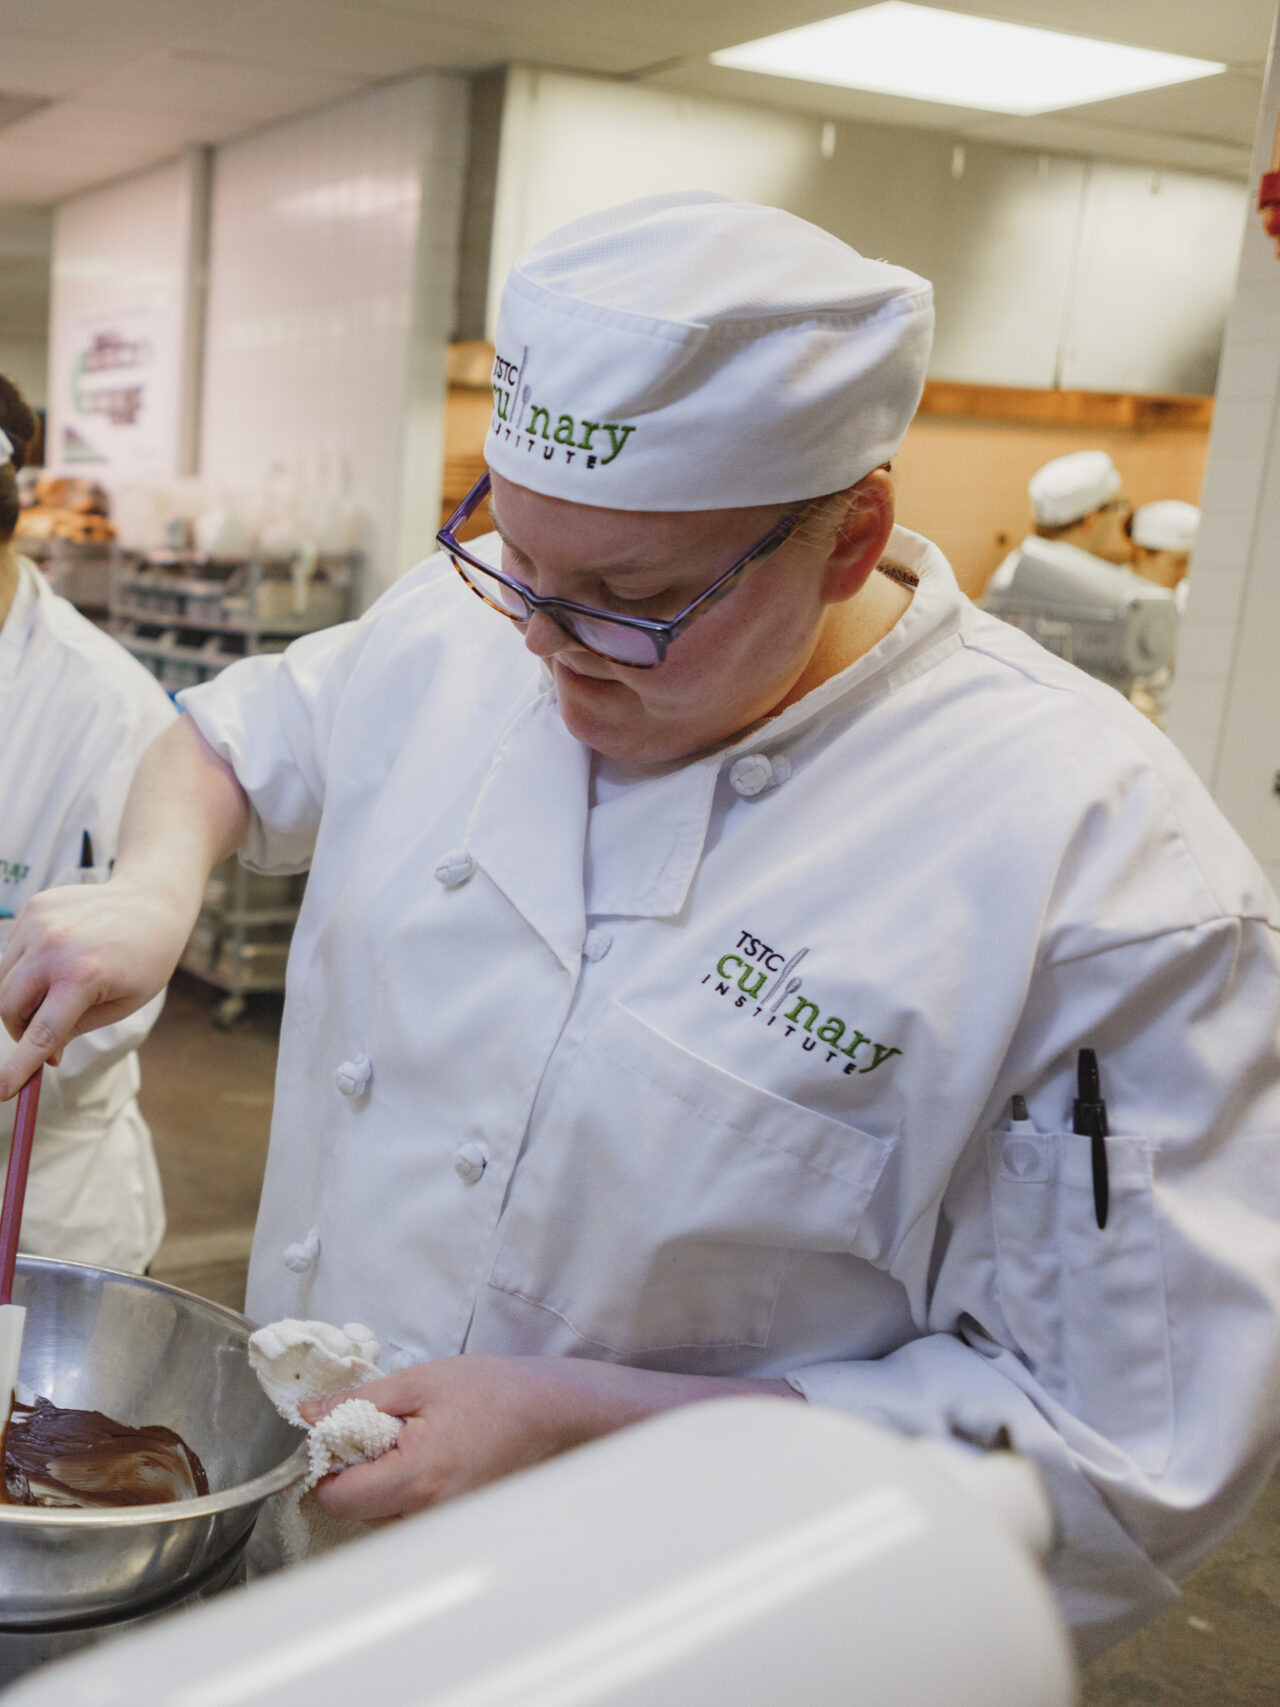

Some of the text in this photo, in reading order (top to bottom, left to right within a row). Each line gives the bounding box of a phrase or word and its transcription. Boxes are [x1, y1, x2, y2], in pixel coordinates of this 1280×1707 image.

[493, 355, 519, 386] TSTC
[493, 346, 636, 465] ulinary
[736, 930, 785, 972] TSTC
[701, 974, 857, 1075] INSTITUTE
